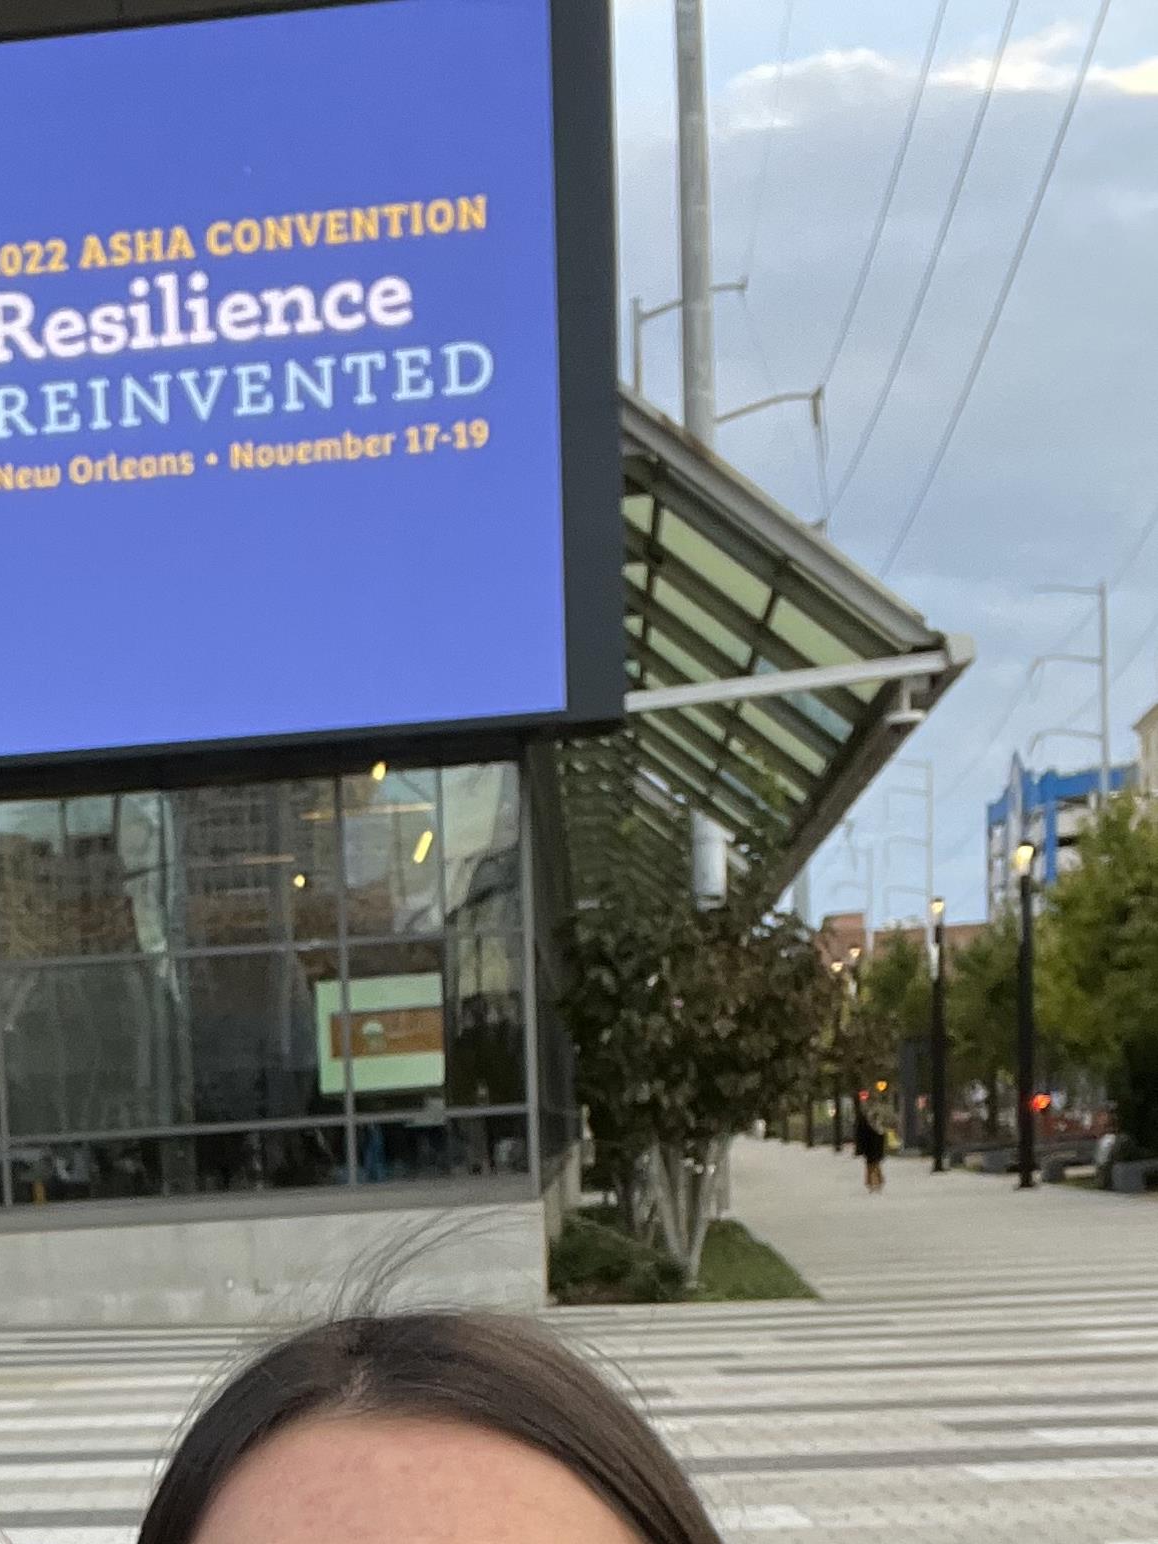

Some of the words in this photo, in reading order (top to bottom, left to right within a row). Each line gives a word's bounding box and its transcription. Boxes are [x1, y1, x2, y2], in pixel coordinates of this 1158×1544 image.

[79, 226, 196, 269] ASHA
[206, 194, 489, 256] CONVENTION
[69, 450, 195, 486] Orleans
[229, 434, 394, 470] November
[405, 418, 490, 455] 17-19
